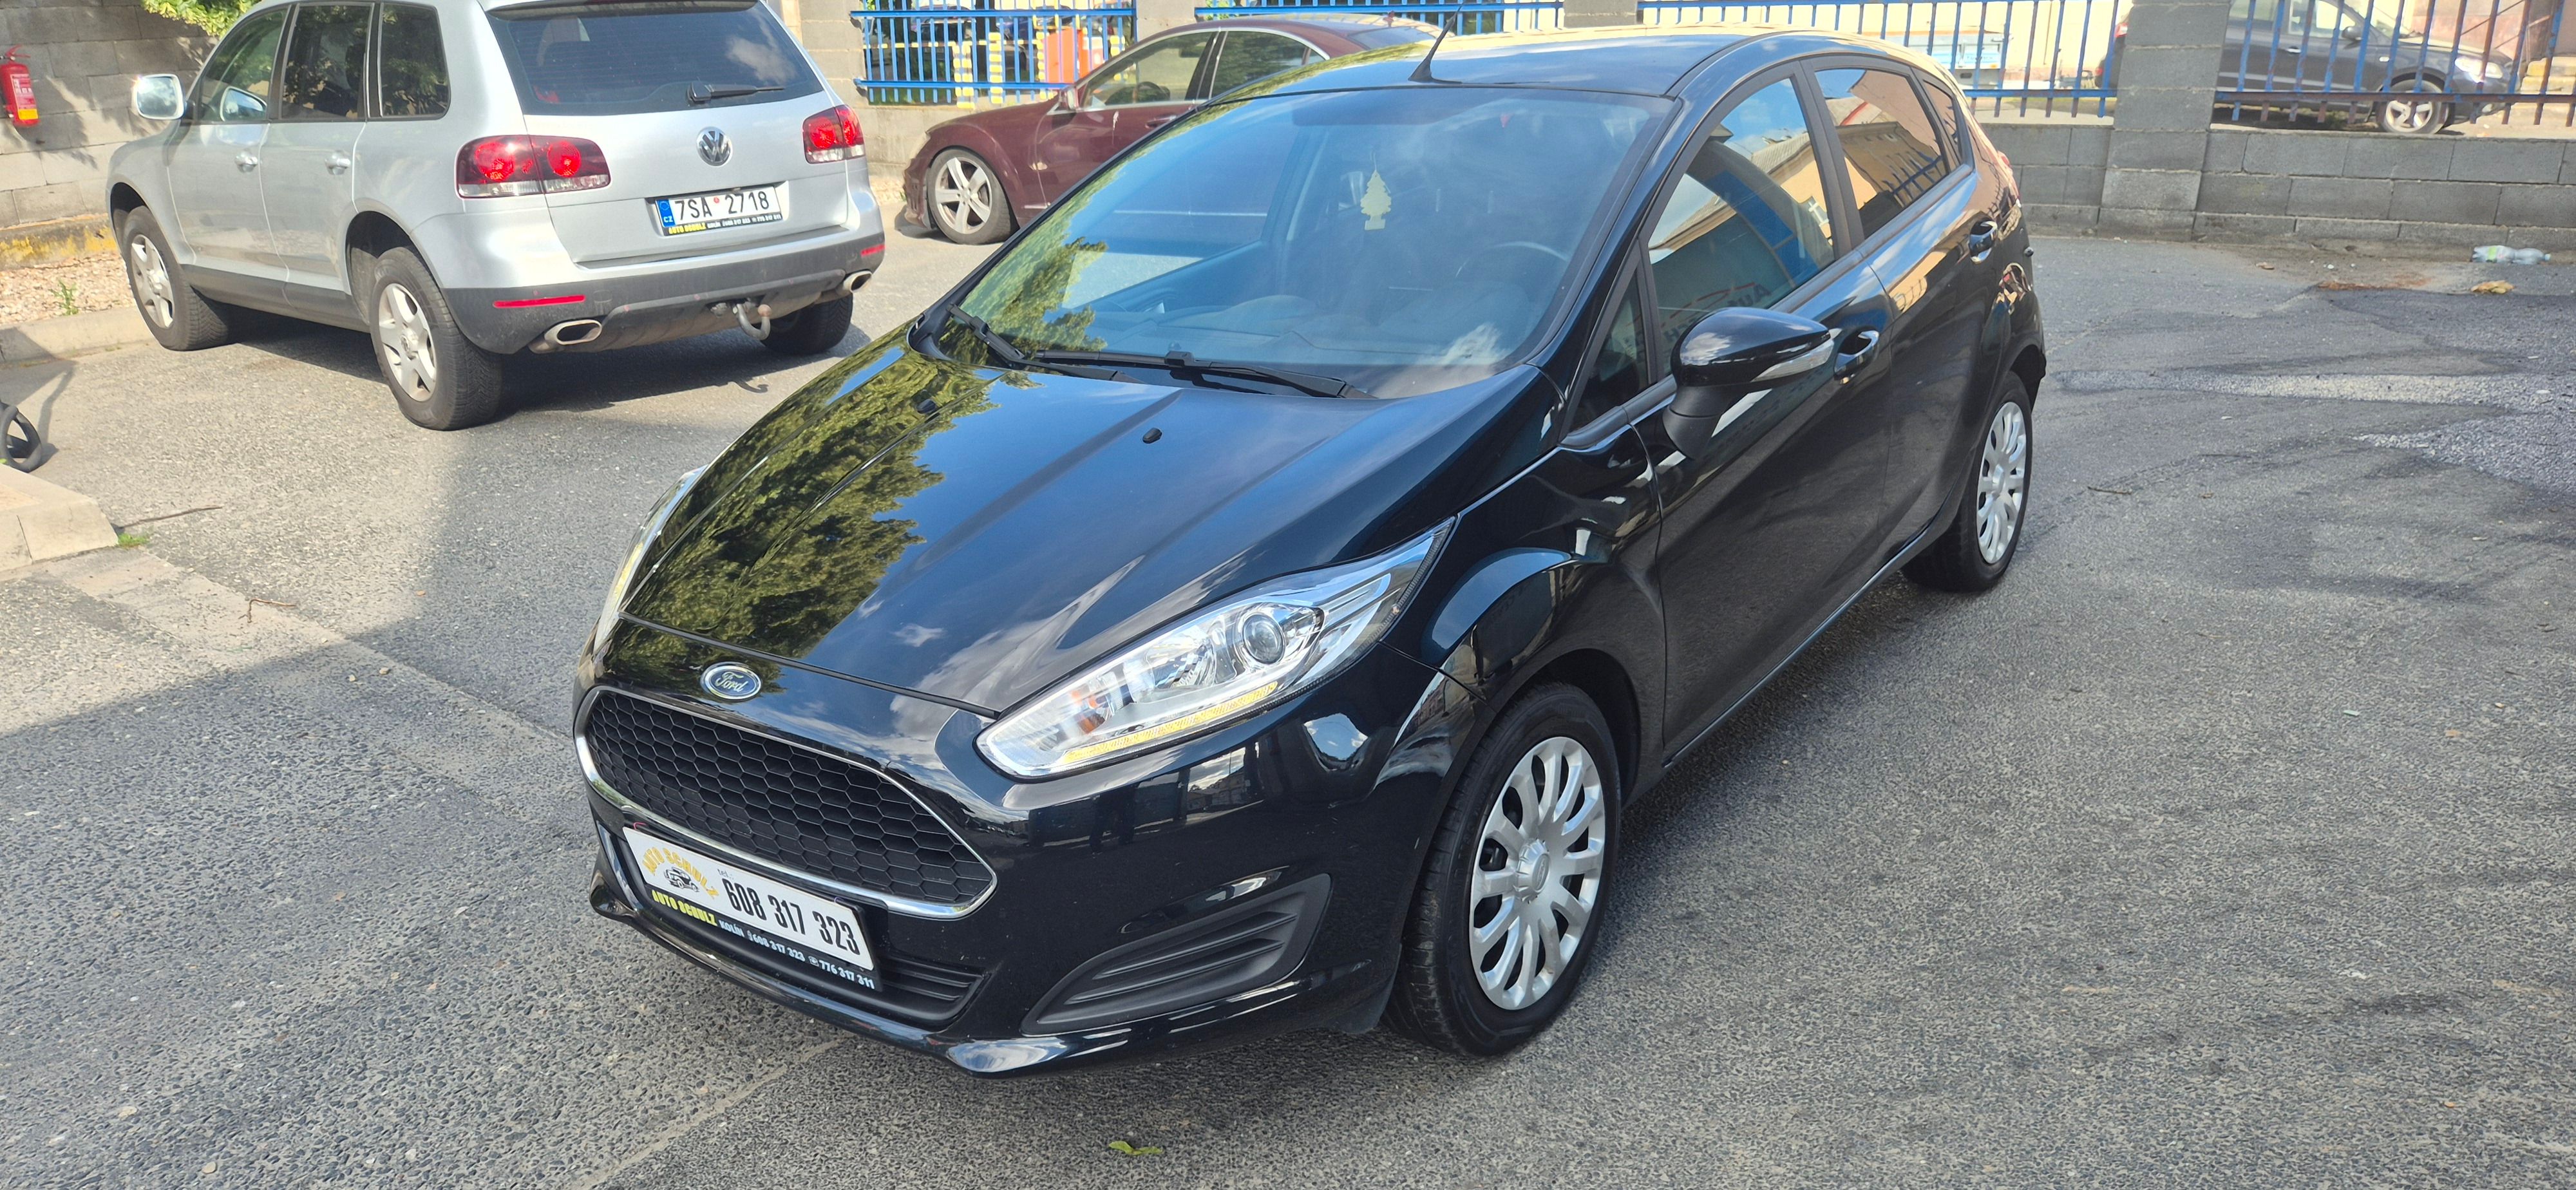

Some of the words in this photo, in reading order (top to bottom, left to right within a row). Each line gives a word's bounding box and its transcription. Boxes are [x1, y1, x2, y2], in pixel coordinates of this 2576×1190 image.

[674, 195, 712, 220] 7SA
[724, 191, 770, 214] 2718
[715, 671, 748, 692] Ford
[643, 847, 665, 876] AUTO
[663, 847, 719, 900] SCHULZ
[652, 889, 678, 911] AUTO
[677, 900, 717, 926] SCHULZ
[718, 920, 745, 938] KOLÍN
[752, 934, 770, 948] 608
[769, 940, 786, 954] 317
[786, 947, 806, 962] 323
[819, 959, 837, 975] 776
[838, 967, 855, 981] 317
[857, 974, 875, 990] 311
[721, 878, 767, 921] 608
[768, 894, 806, 936] 317
[812, 911, 860, 956] 323
